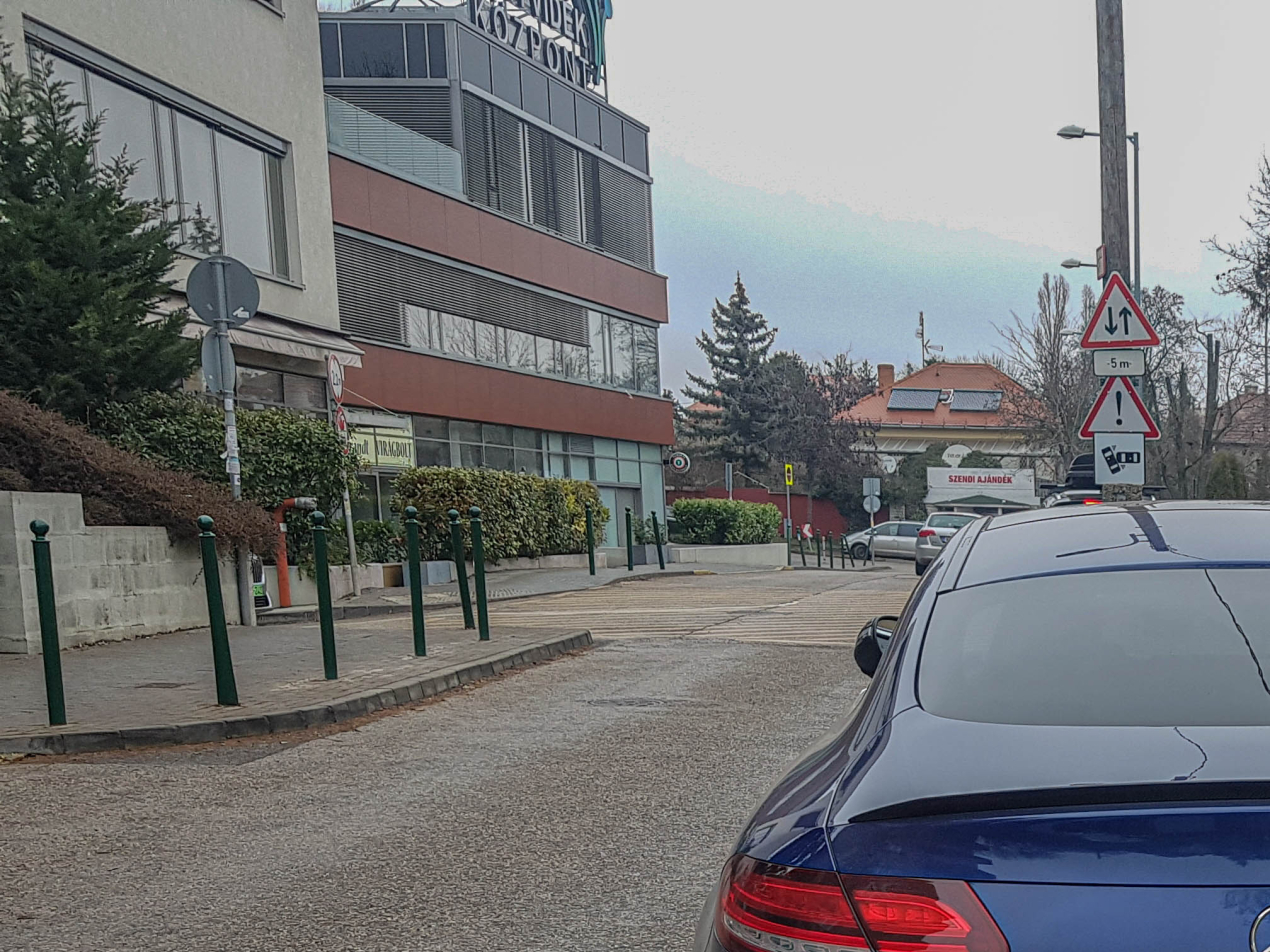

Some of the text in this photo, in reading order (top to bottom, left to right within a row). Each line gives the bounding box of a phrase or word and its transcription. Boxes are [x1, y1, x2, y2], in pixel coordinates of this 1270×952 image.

[472, 0, 590, 91] KÖZPONT
[375, 439, 412, 459] VIRÁGBOLT
[948, 474, 1013, 484] SZENDI AJÁNDÉK
